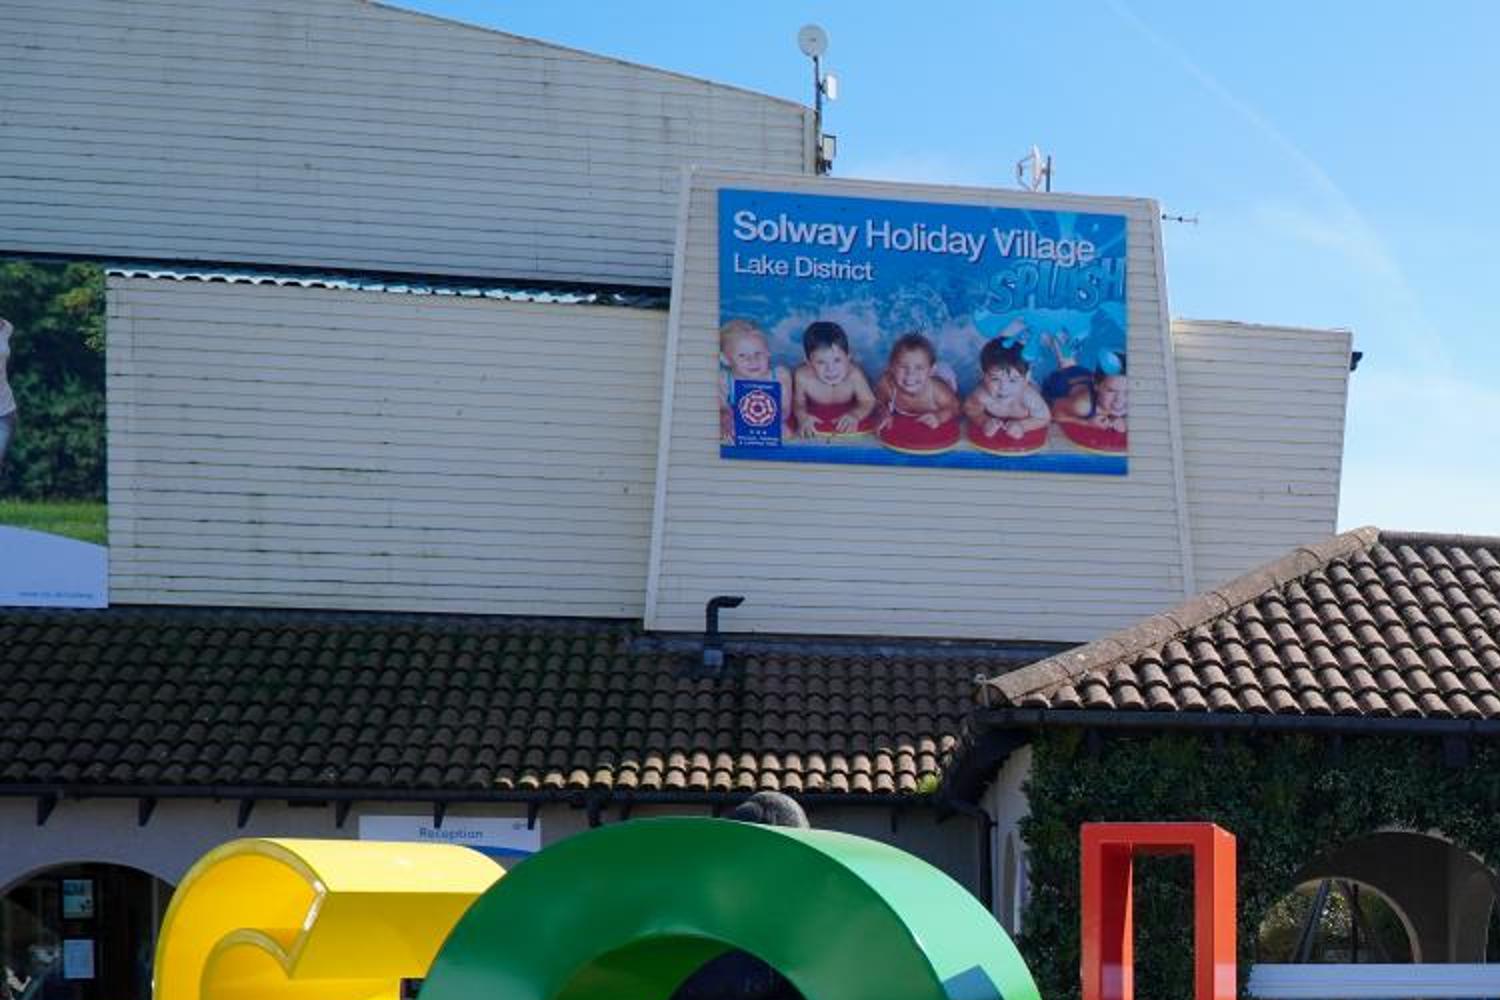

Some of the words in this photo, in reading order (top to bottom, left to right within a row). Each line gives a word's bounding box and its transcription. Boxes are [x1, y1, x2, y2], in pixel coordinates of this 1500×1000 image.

[733, 210, 857, 253] Solway
[865, 219, 986, 263] Holiday
[992, 226, 1096, 268] Village
[733, 252, 789, 275] Lake
[795, 255, 874, 281] District
[418, 826, 484, 841] Reception
